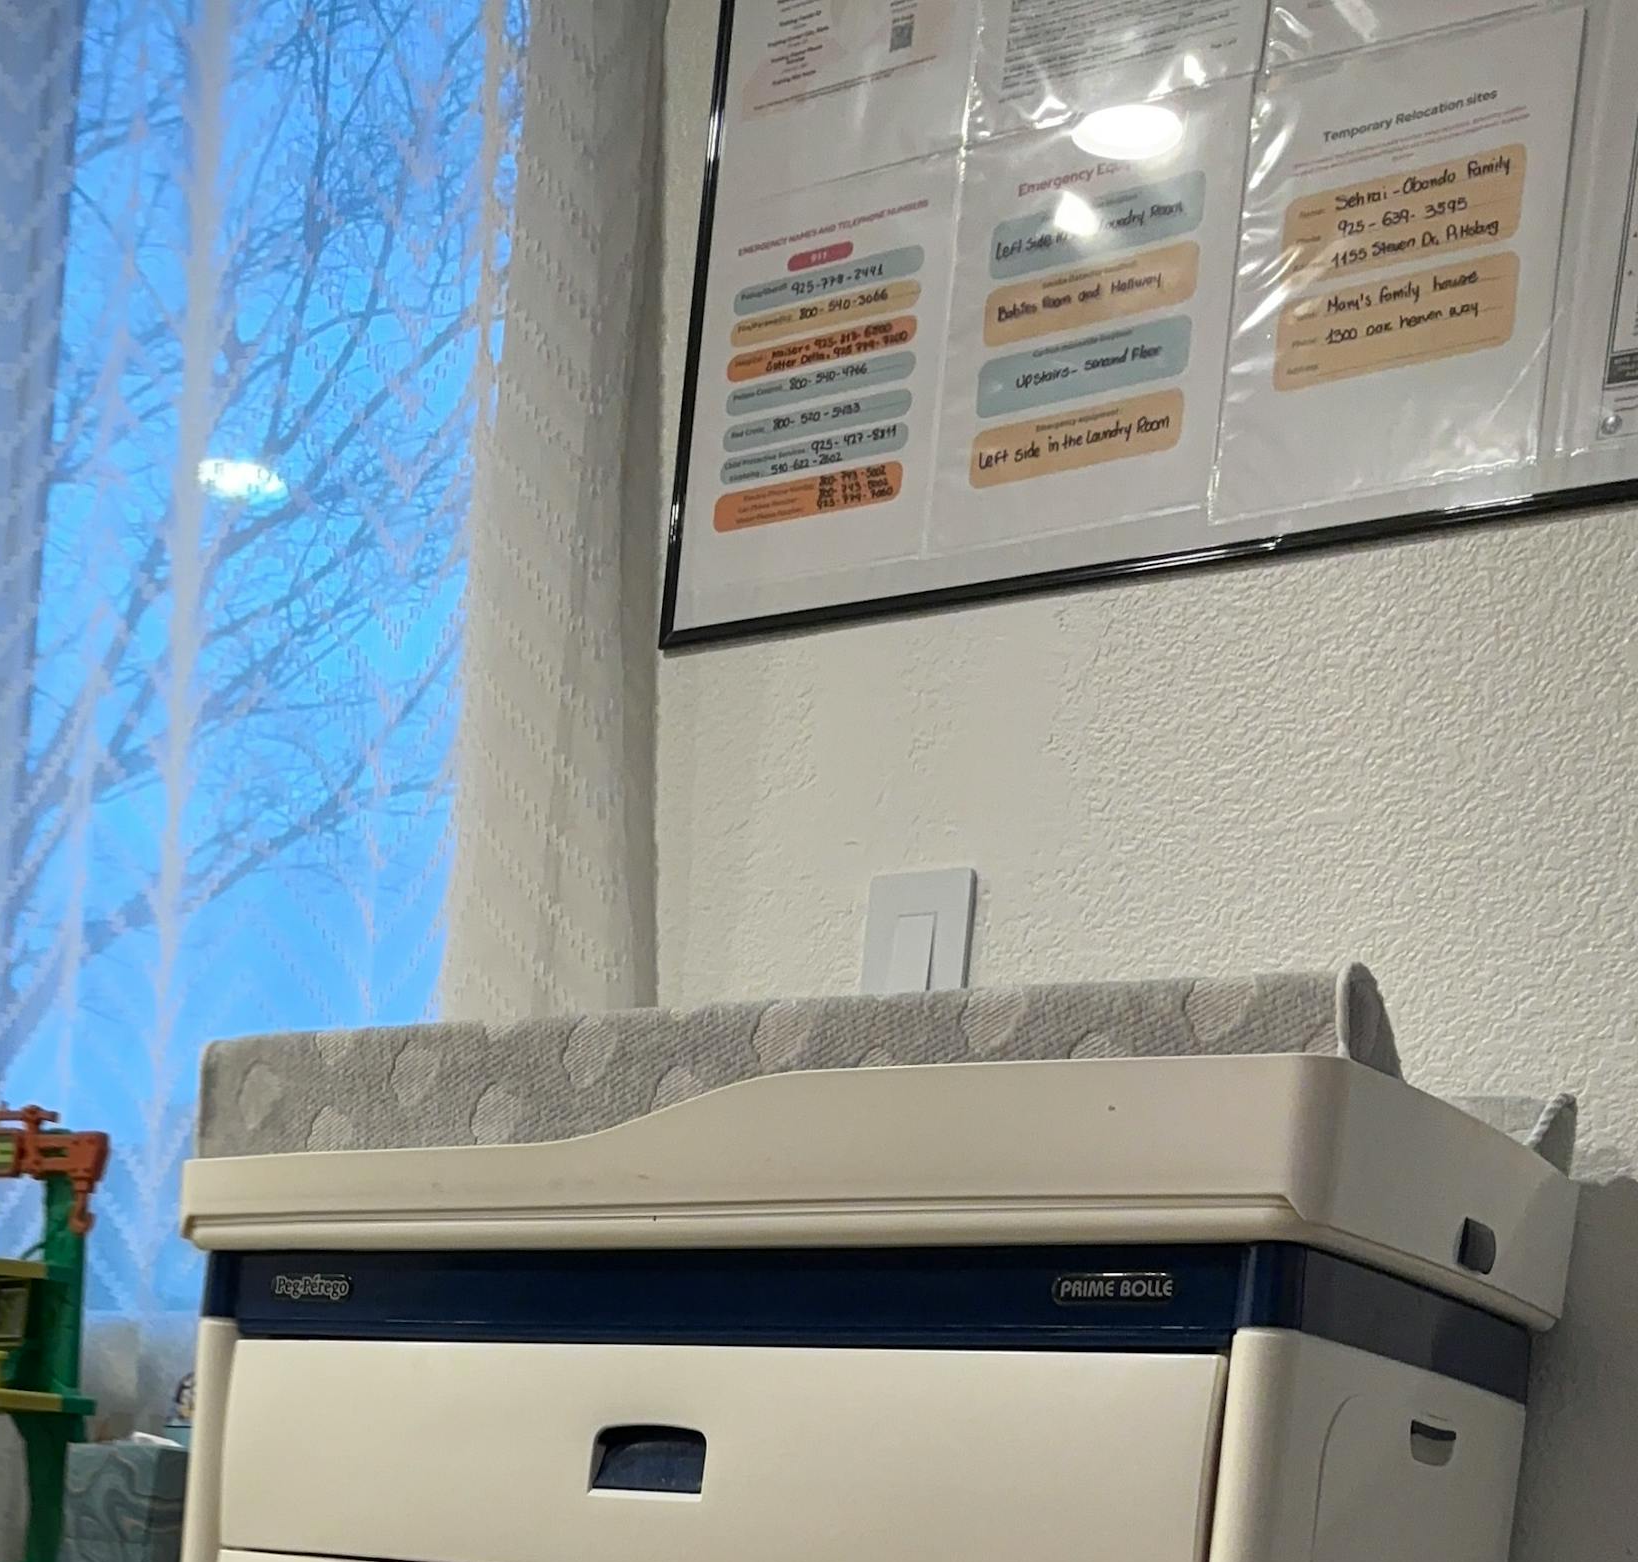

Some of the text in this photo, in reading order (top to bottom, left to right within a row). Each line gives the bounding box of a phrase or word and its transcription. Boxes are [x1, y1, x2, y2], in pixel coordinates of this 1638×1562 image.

[1323, 118, 1393, 142] Temporary
[1395, 100, 1464, 126] Relocation
[1466, 89, 1498, 106] sites
[1019, 168, 1094, 197] Emergency
[1060, 1280, 1173, 1297] PRIME BOLLE
